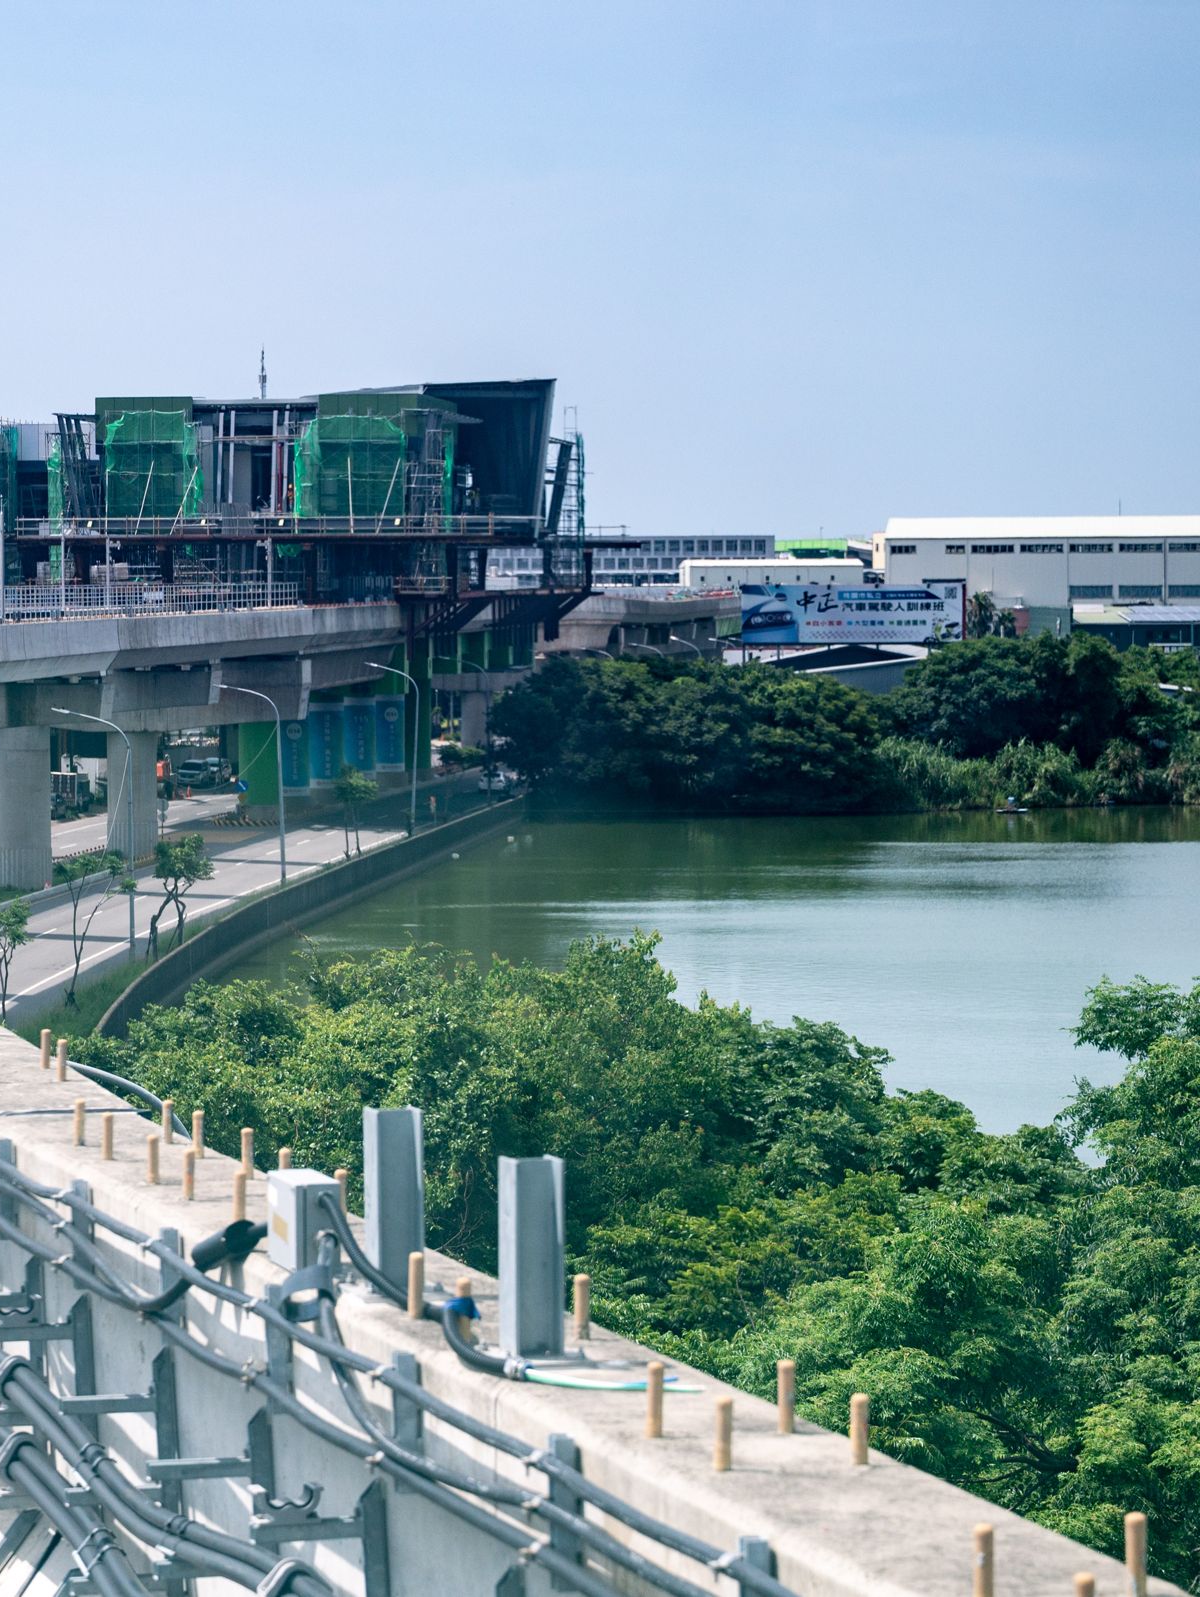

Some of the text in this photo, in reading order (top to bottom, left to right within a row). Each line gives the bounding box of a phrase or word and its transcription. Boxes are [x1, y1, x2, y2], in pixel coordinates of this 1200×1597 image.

[796, 591, 839, 614] 中正
[842, 602, 945, 612] 汽車駕駛人訓練班
